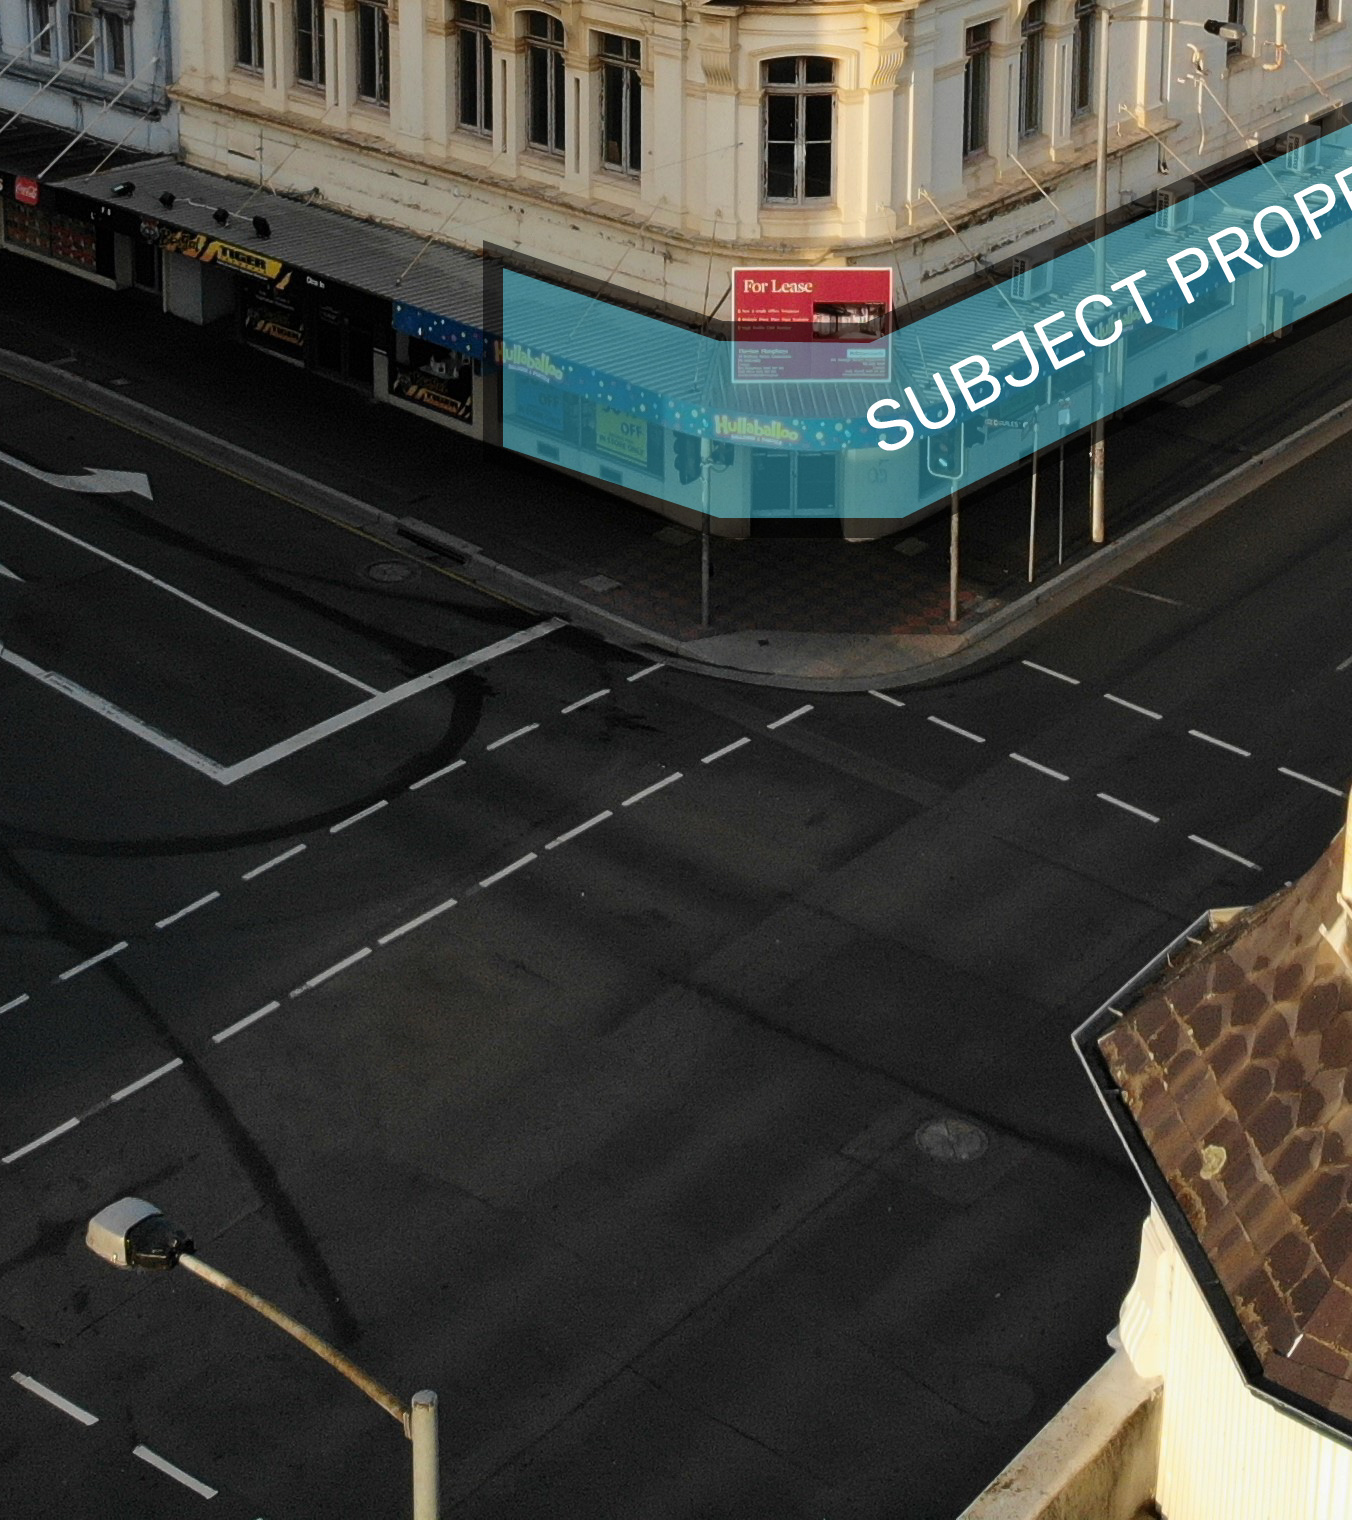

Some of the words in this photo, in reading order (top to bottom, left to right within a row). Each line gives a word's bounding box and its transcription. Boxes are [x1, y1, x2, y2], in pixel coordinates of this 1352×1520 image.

[219, 244, 267, 271] TIGER
[743, 279, 768, 293] For
[771, 279, 814, 294] Lease
[620, 422, 642, 438] OFF
[714, 414, 799, 442] Hullaballoo
